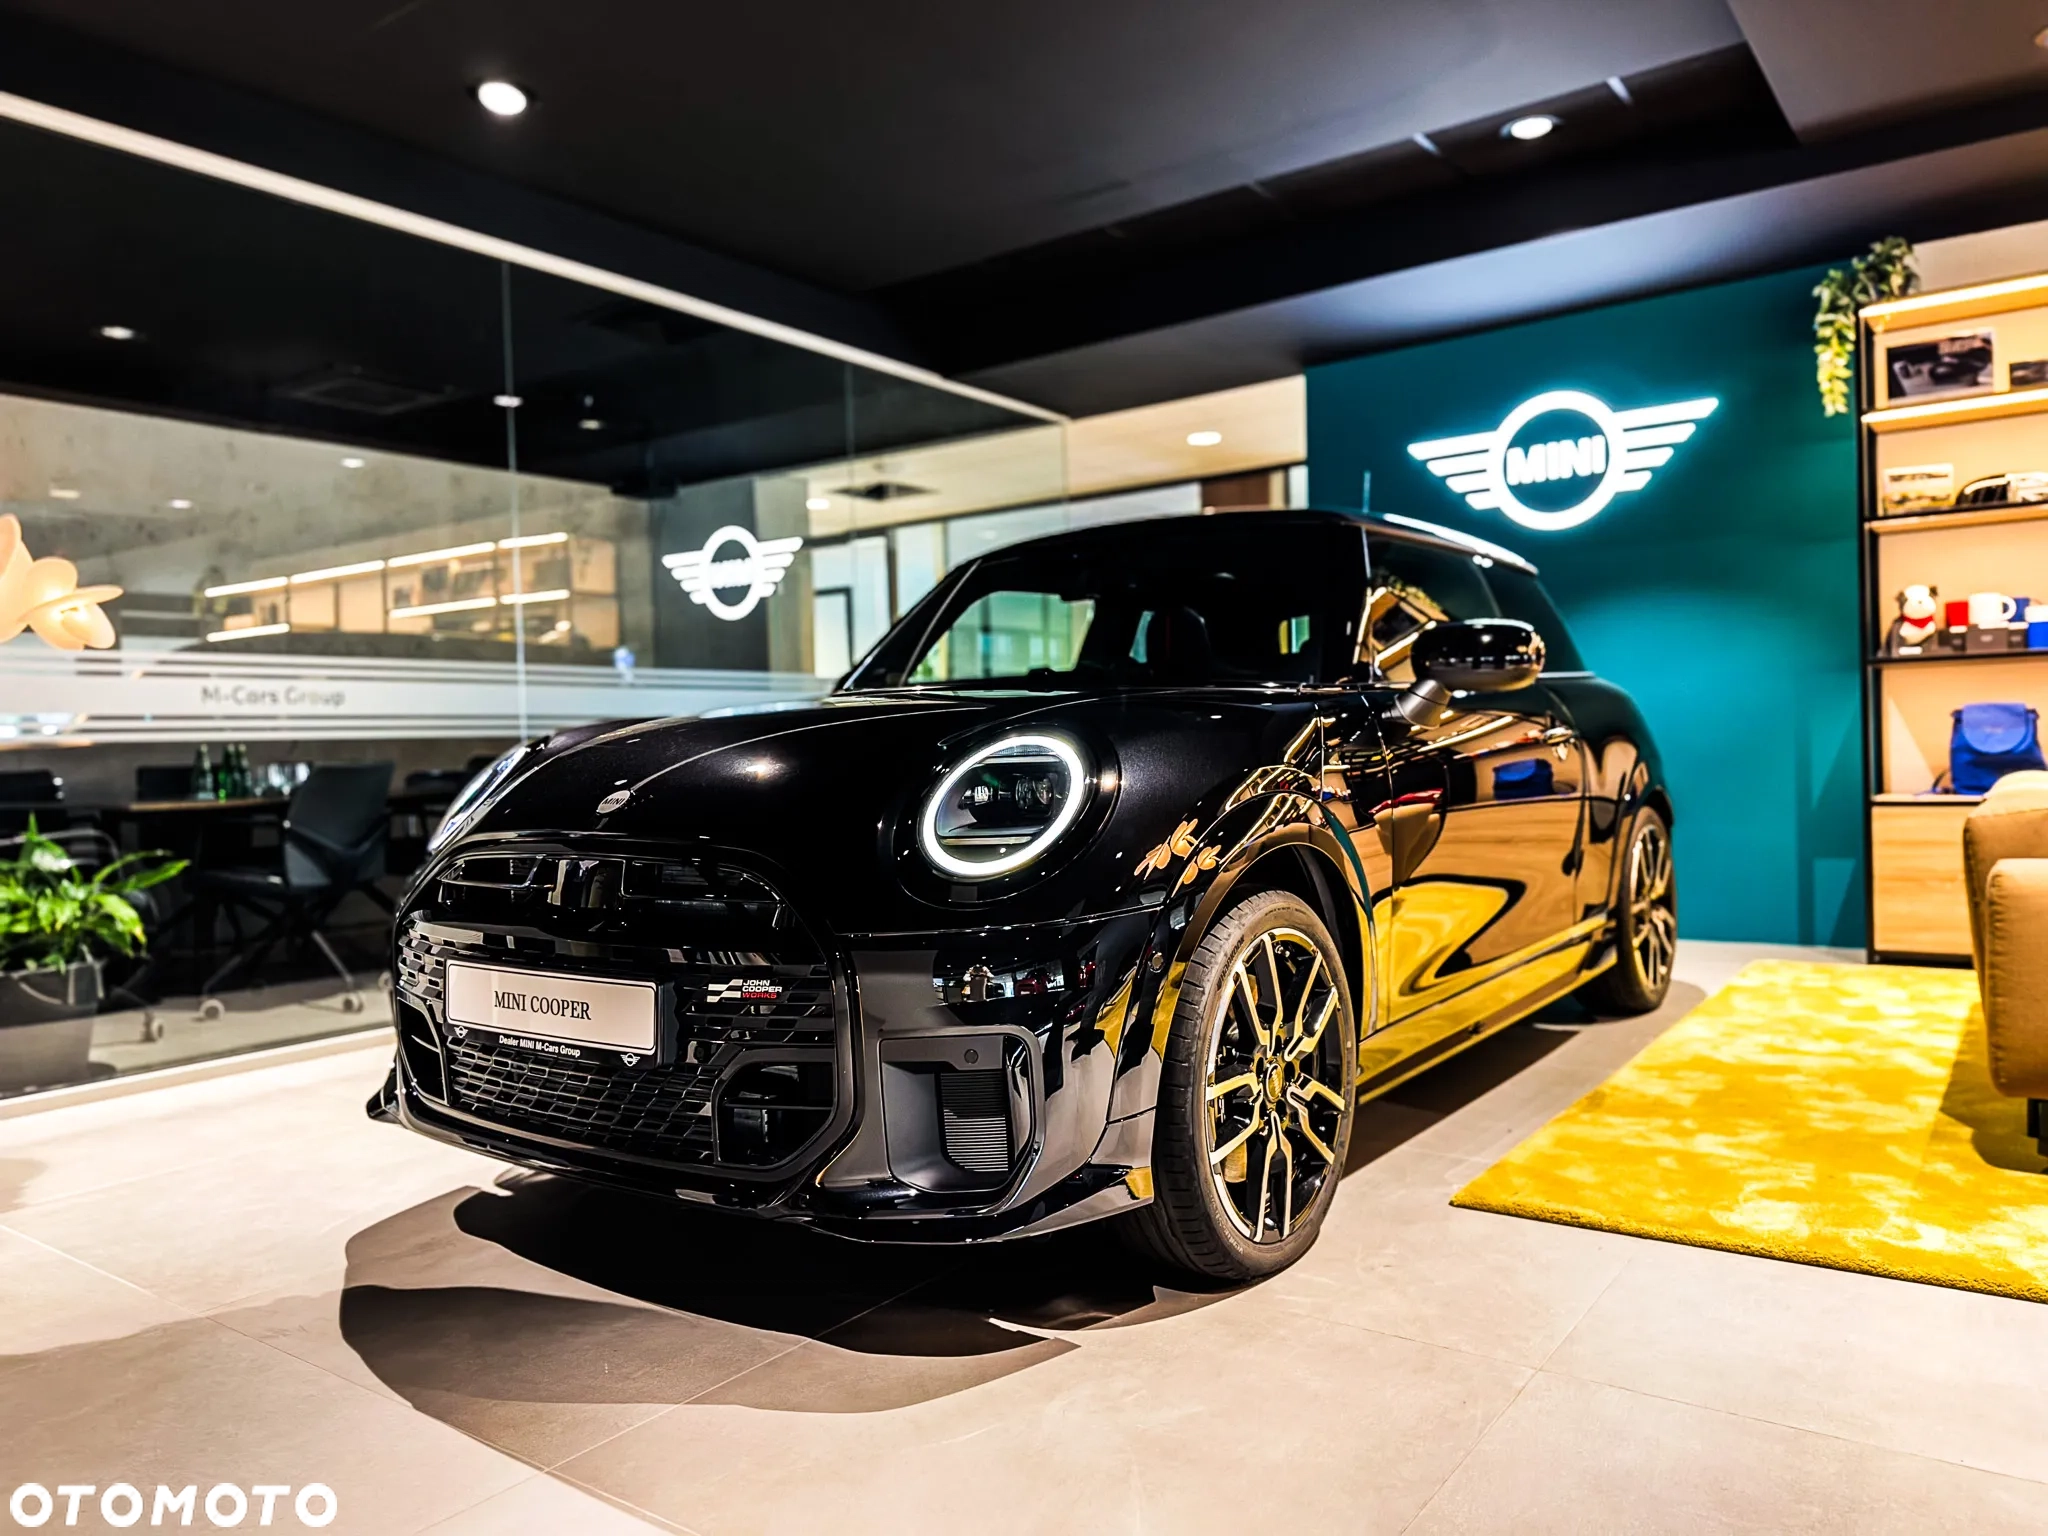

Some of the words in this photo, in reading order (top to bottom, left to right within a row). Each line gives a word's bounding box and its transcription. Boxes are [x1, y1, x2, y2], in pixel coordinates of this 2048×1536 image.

[1505, 434, 1606, 486] MINI
[201, 685, 279, 706] M-Cars
[742, 985, 783, 993] COOPER
[494, 990, 527, 1011] MINI
[530, 995, 592, 1020] COOPER
[499, 1035, 519, 1046] Dealer
[520, 1039, 535, 1049] MINI
[536, 1041, 559, 1053] M-Cars
[560, 1045, 581, 1058] Group
